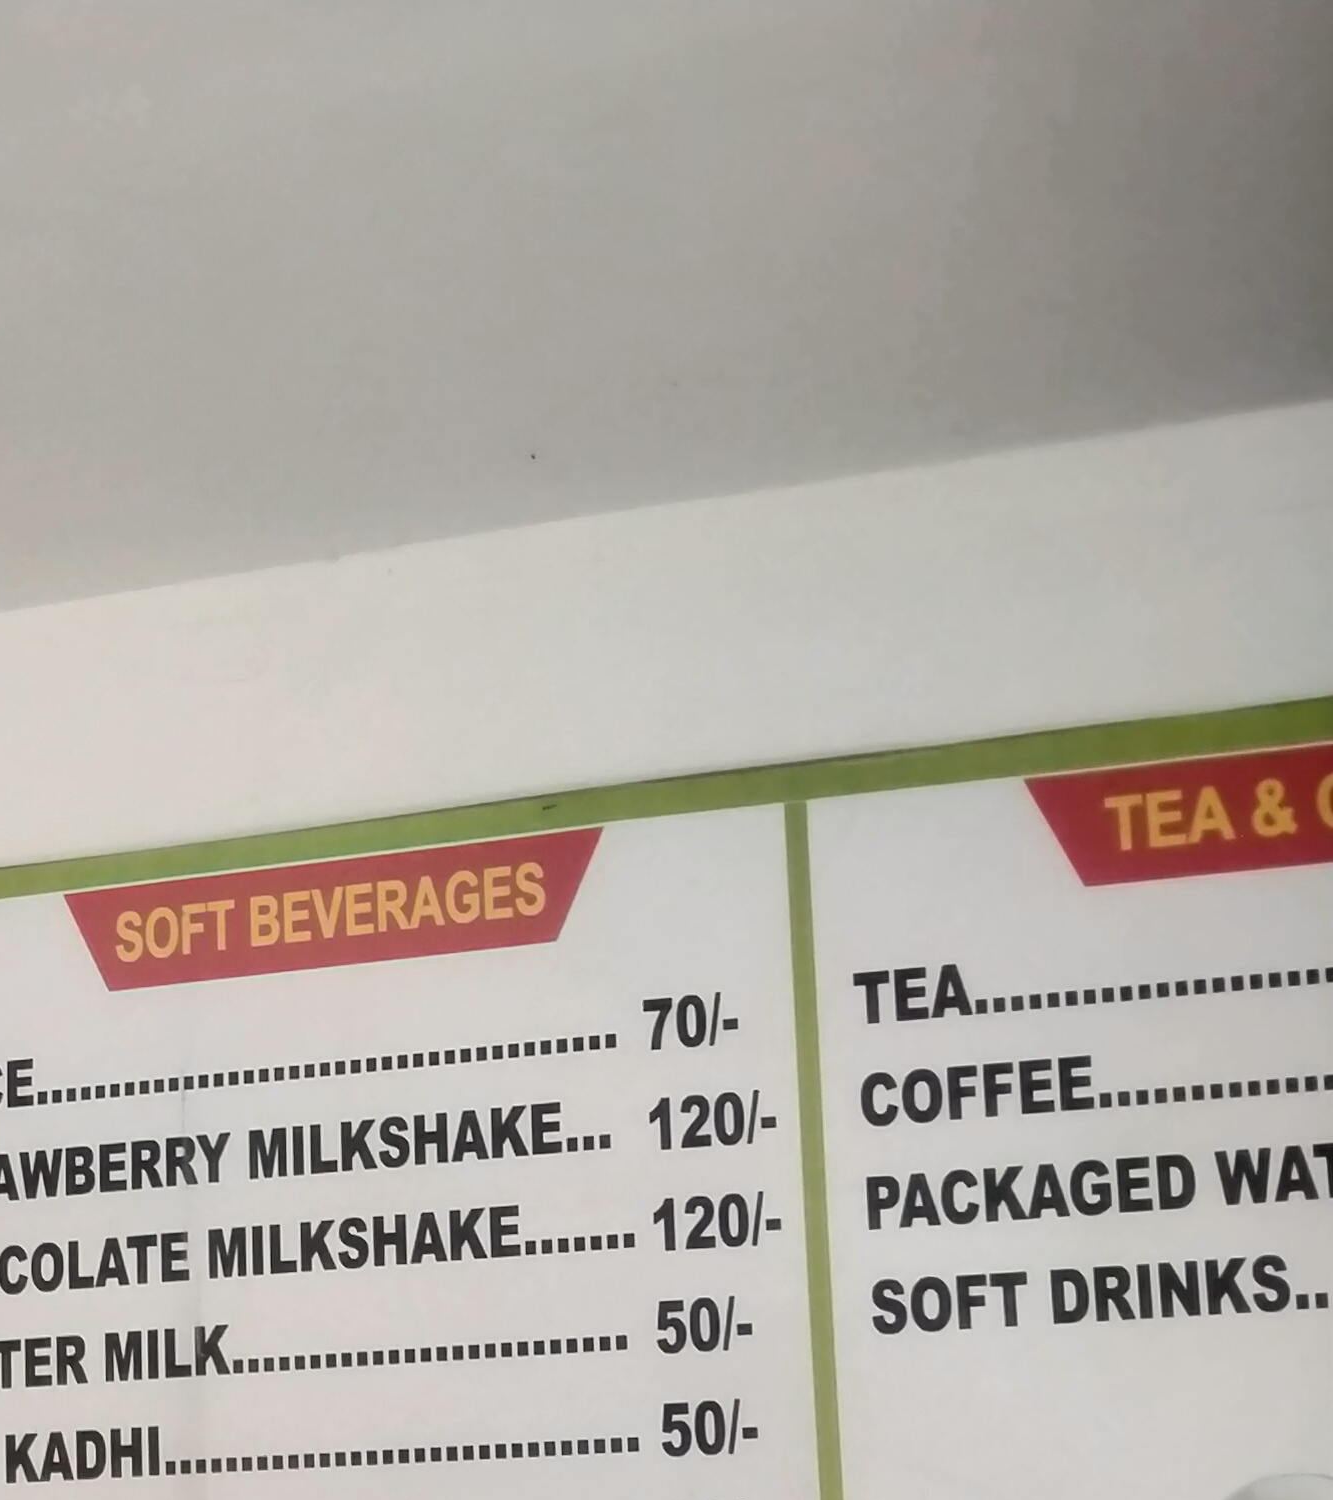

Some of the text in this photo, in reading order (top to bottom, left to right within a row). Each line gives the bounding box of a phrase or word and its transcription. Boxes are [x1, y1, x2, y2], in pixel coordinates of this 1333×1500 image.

[1104, 786, 1236, 851] TEA
[1251, 778, 1298, 837] &
[115, 860, 548, 963] SOFT BEVERAGES
[642, 991, 739, 1051] 70/-
[648, 1090, 777, 1151] 120/-
[653, 1190, 782, 1252] 120/-
[866, 1154, 1196, 1231] PACKAGED
[656, 1295, 753, 1355] 50/-
[871, 1271, 1028, 1335] SOFT
[661, 1398, 759, 1458] 50/-
